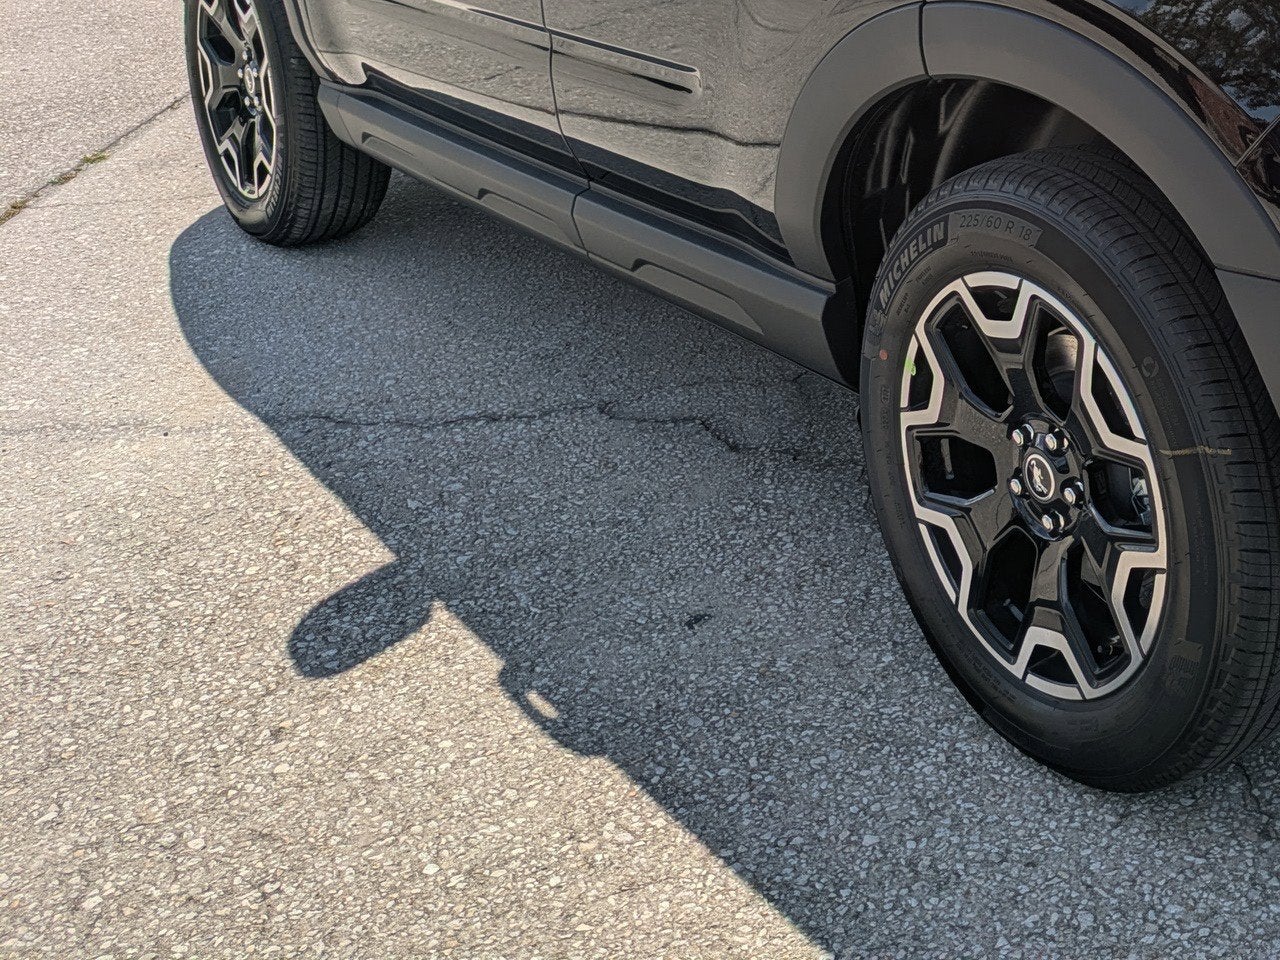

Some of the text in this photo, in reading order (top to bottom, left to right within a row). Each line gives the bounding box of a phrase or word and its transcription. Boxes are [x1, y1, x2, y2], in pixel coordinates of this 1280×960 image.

[959, 213, 1033, 241] 225/60 R 18
[878, 220, 946, 310] MICHELIN
